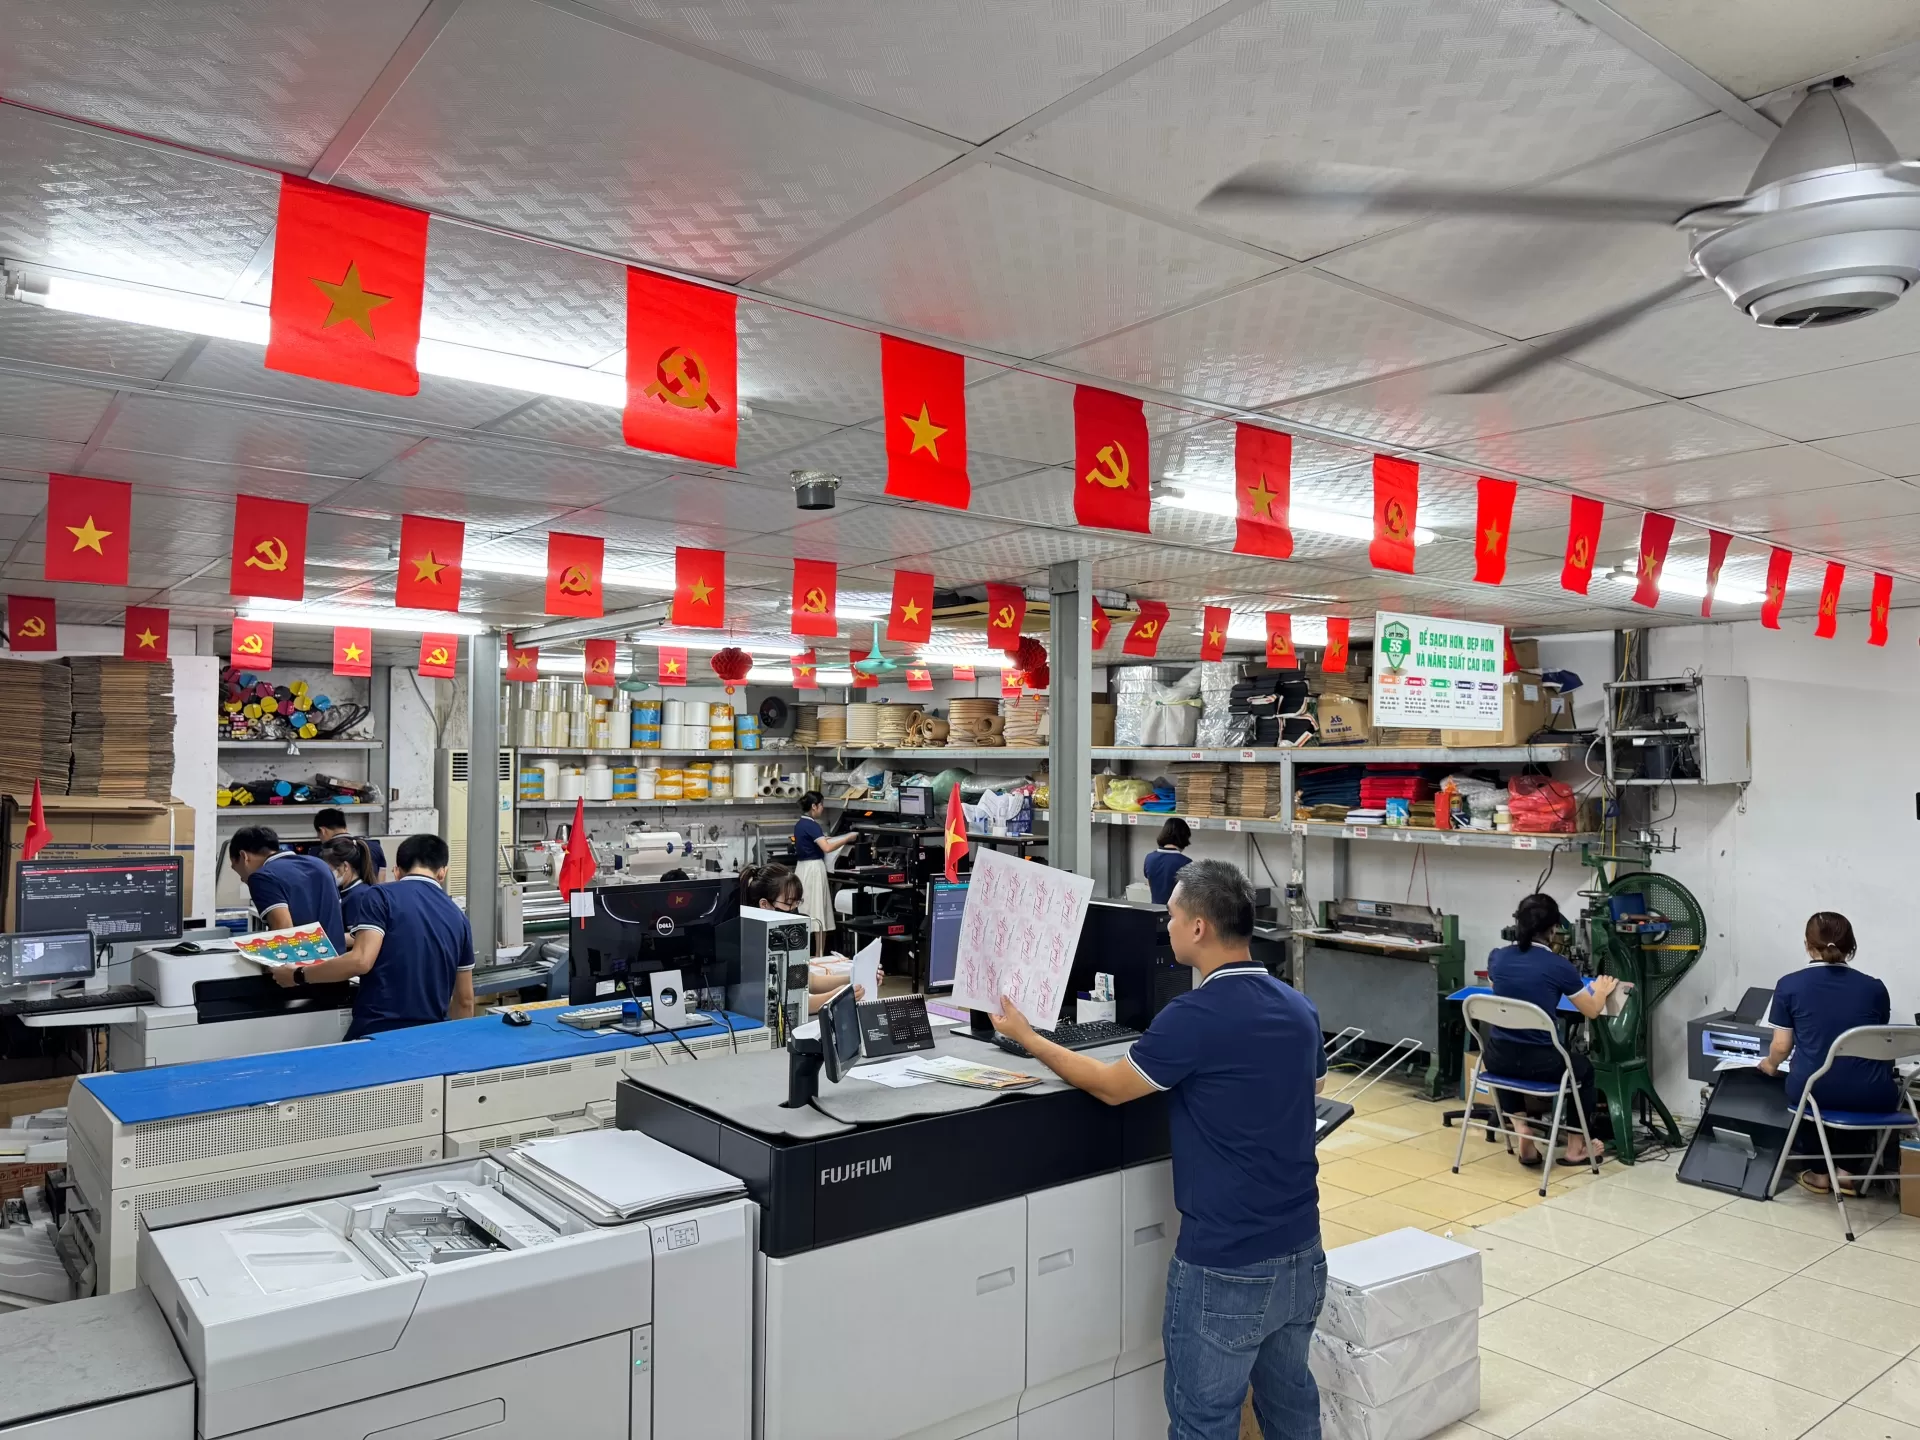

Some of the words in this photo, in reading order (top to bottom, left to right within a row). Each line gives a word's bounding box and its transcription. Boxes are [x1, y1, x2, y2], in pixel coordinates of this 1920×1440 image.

[1389, 639, 1402, 652] 5S
[1429, 633, 1447, 650] SẠCH
[1480, 638, 1494, 653] HƠN
[1416, 650, 1425, 667] VÀ
[1427, 652, 1447, 669] NĂNG
[1449, 652, 1466, 670] SUẤT
[1467, 657, 1480, 672] CAO
[1481, 658, 1496, 673] HƠN
[820, 1154, 892, 1186] FUJIFILM
[657, 1236, 665, 1244] A1
